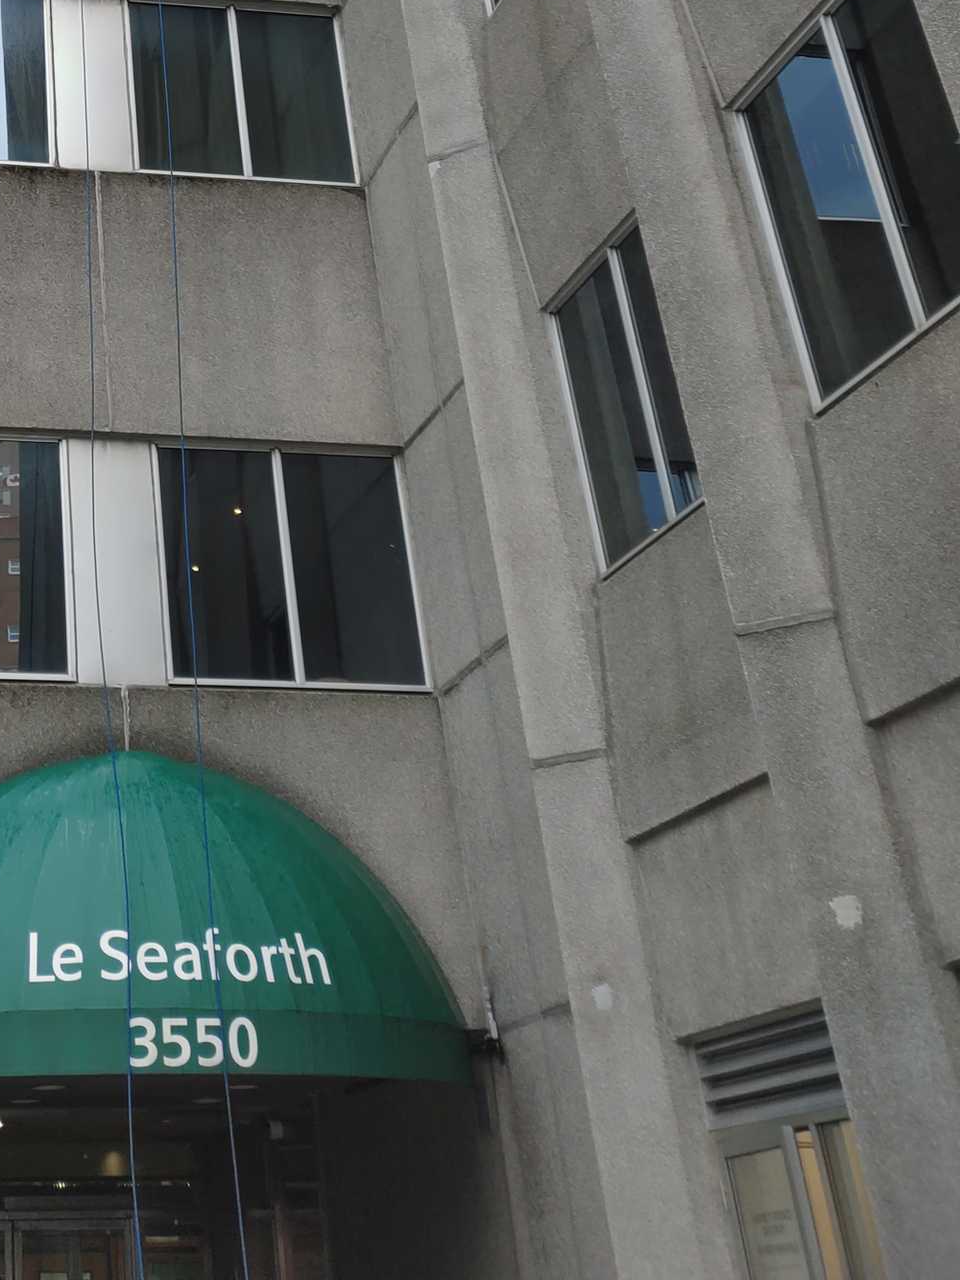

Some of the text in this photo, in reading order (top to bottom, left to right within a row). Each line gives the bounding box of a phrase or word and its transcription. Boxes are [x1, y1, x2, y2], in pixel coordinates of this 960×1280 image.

[28, 927, 332, 985] Le Seaforth
[129, 1017, 258, 1068] 3550
